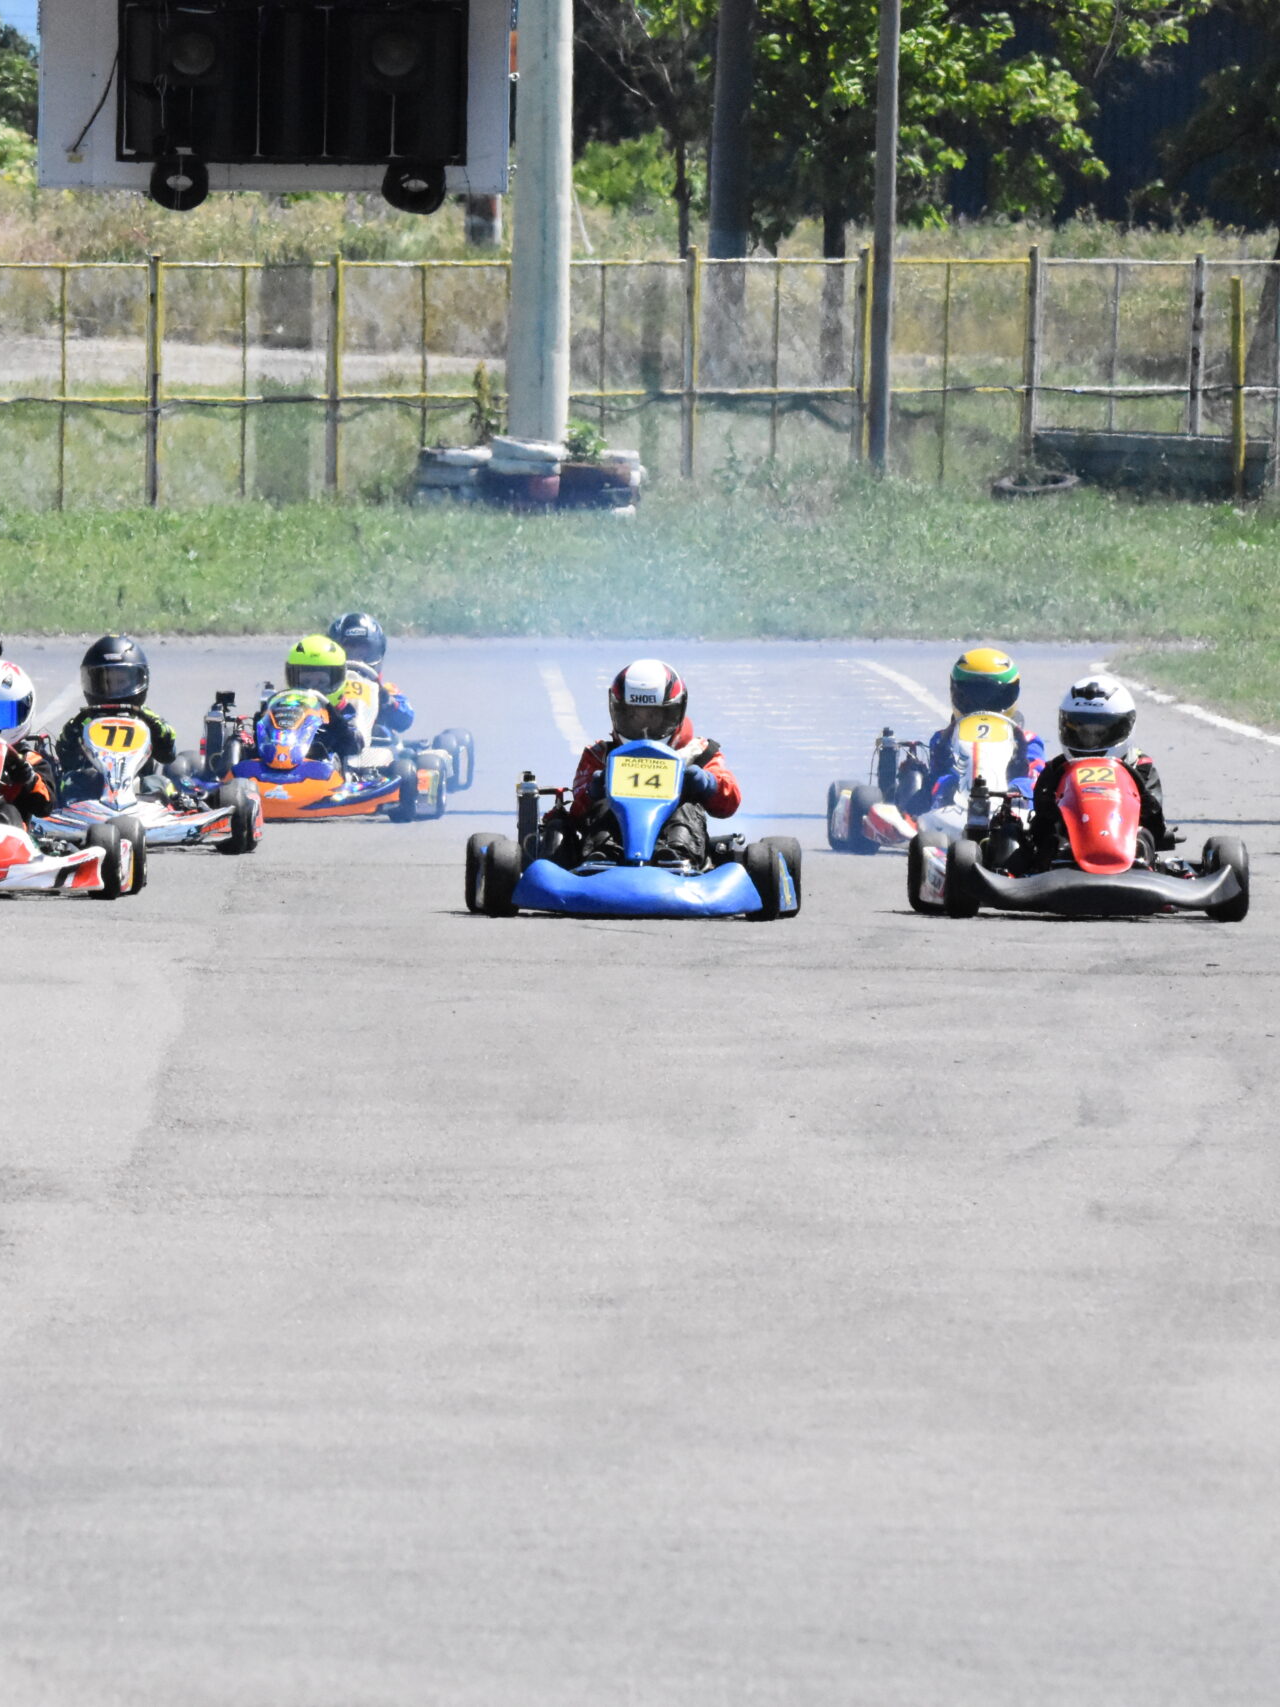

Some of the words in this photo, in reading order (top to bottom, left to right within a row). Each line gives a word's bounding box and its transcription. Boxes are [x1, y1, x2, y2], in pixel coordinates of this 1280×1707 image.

[629, 694, 657, 703] SHOEI
[101, 725, 135, 747] 77
[977, 724, 990, 739] 2
[627, 773, 662, 789] 14
[1078, 767, 1115, 784] 22
